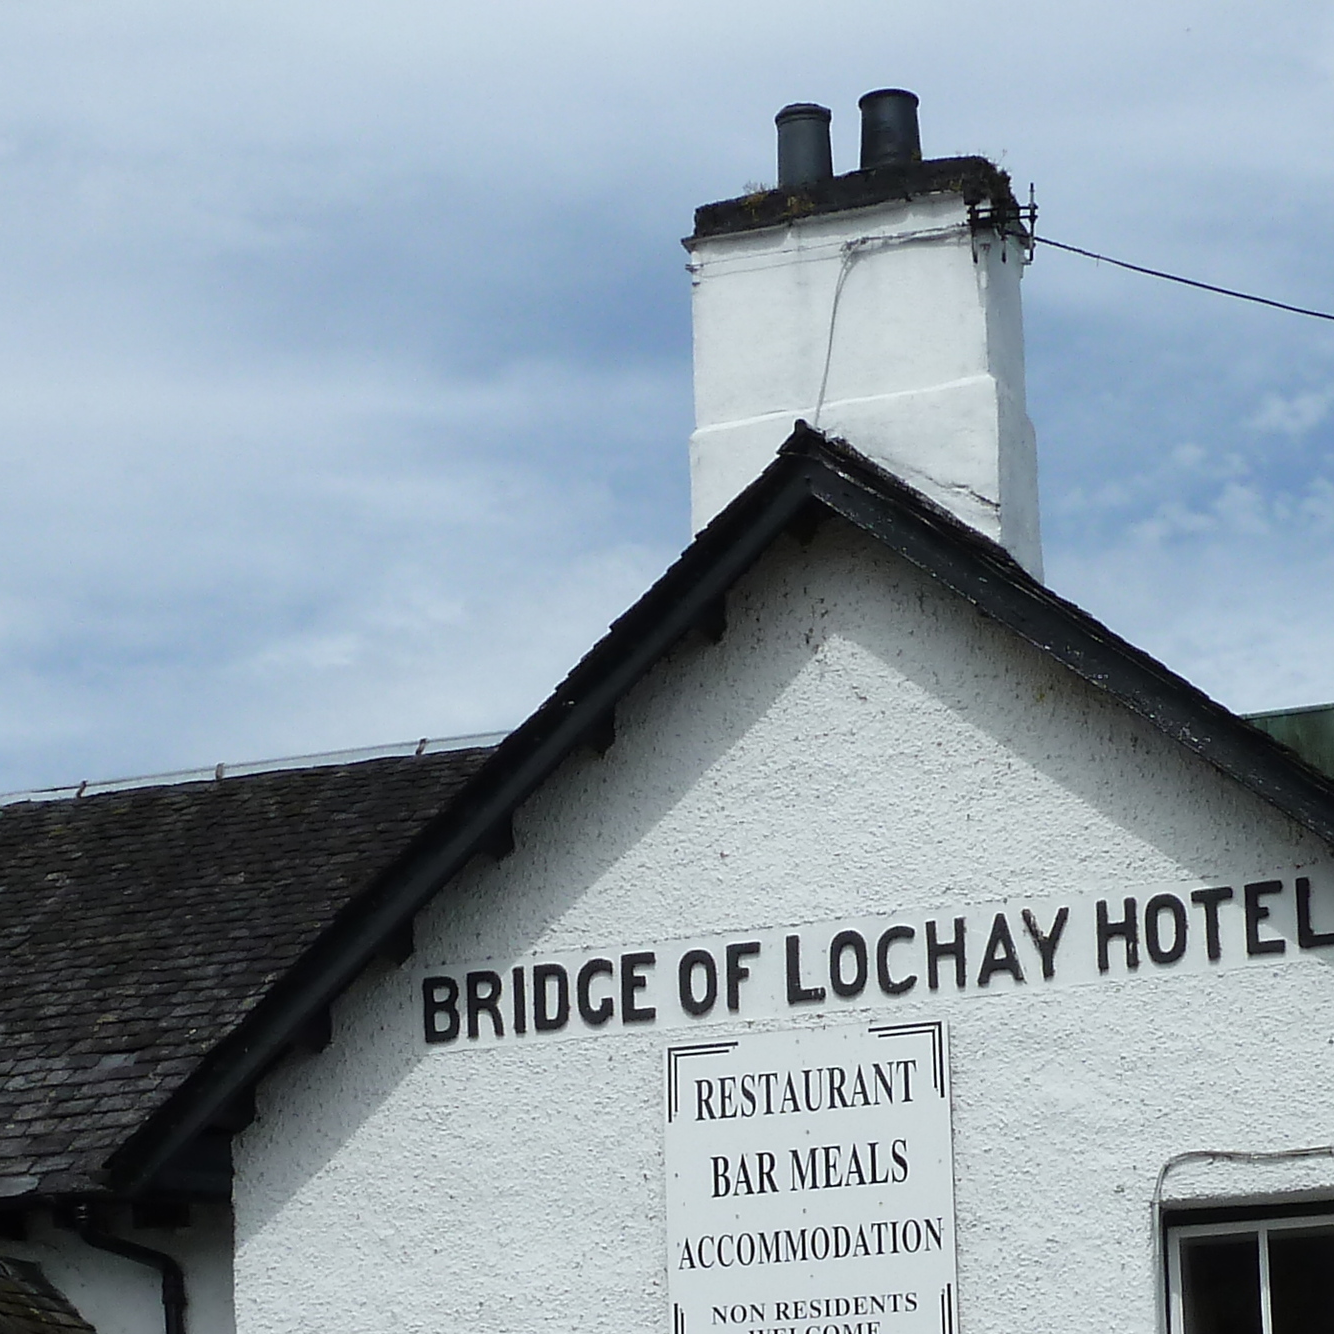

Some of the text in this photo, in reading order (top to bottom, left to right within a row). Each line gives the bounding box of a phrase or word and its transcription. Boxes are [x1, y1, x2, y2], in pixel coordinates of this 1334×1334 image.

[422, 951, 657, 1045] BRIDGE
[678, 941, 762, 1016] OF
[785, 906, 1070, 1005] LOCHAY
[694, 1059, 917, 1121] RESTAURANT
[710, 1138, 909, 1198] BAR MEALS
[678, 1217, 944, 1270] ACCOMMODATION
[711, 1292, 918, 1325] NON RESIDENTS
